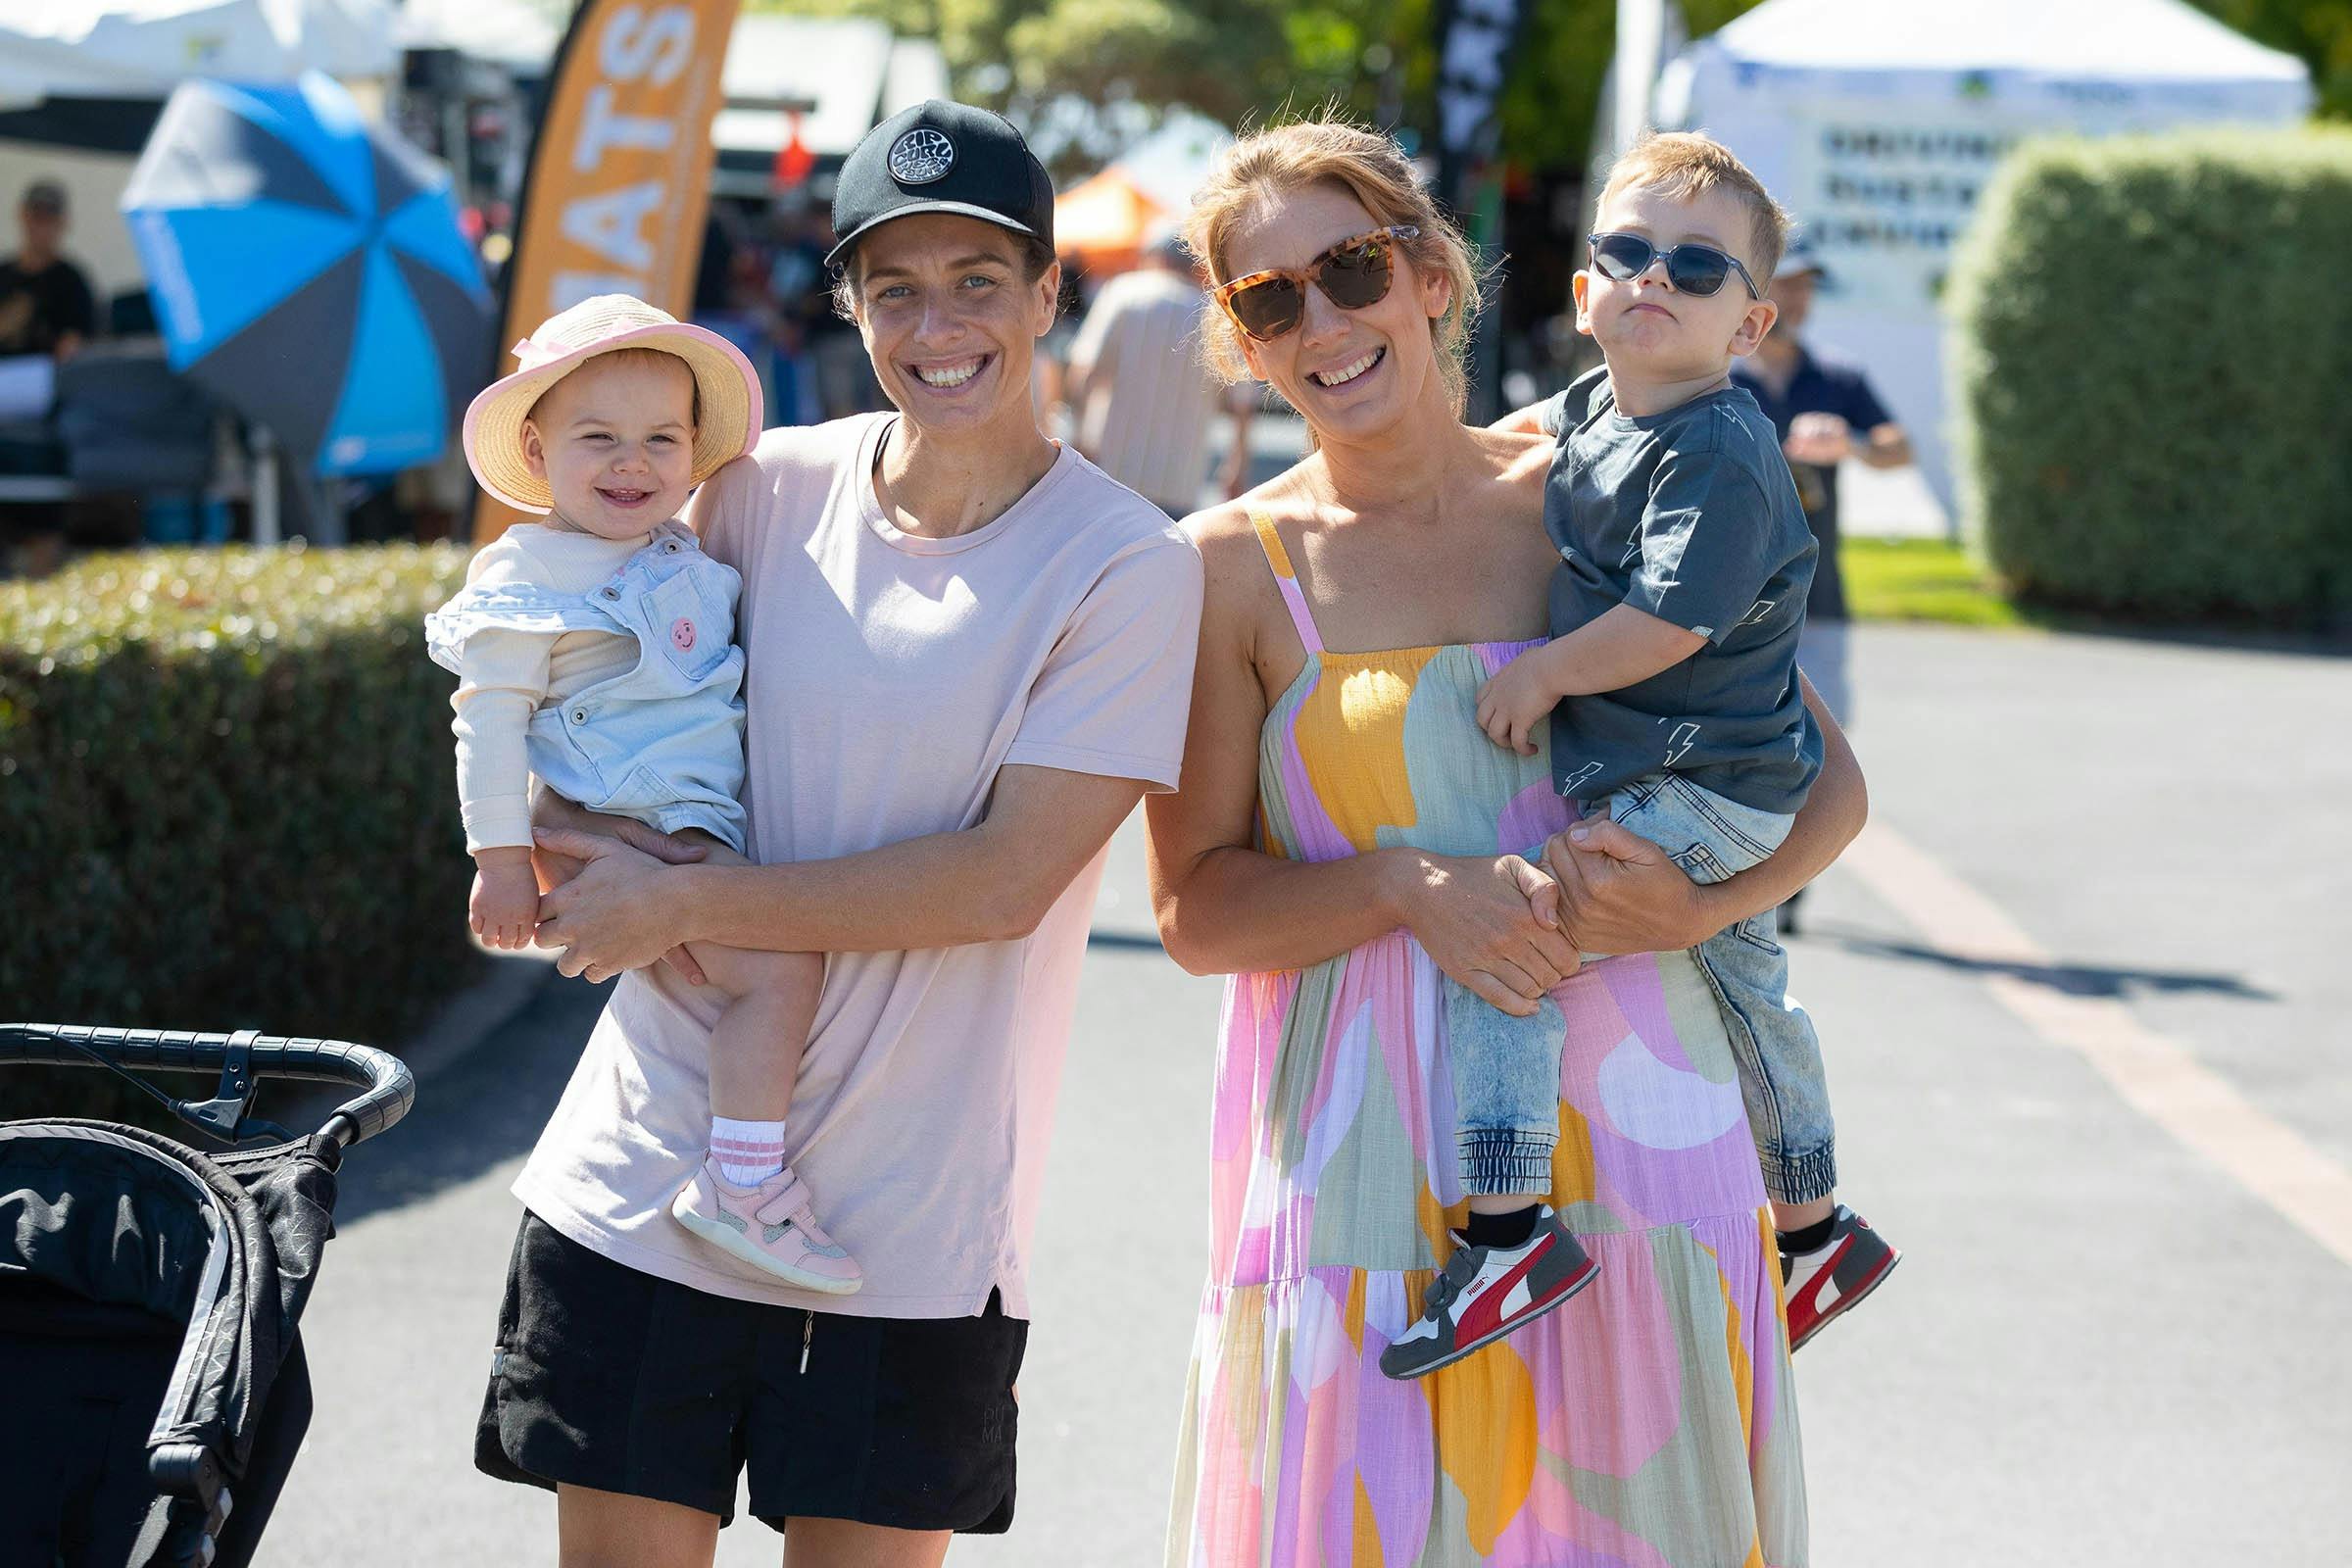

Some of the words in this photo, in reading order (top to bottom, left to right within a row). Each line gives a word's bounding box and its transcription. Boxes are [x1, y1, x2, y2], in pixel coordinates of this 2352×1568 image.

[893, 142, 953, 167] CURL
[894, 130, 943, 155] RIP
[1466, 1279, 1486, 1297] PUMA
